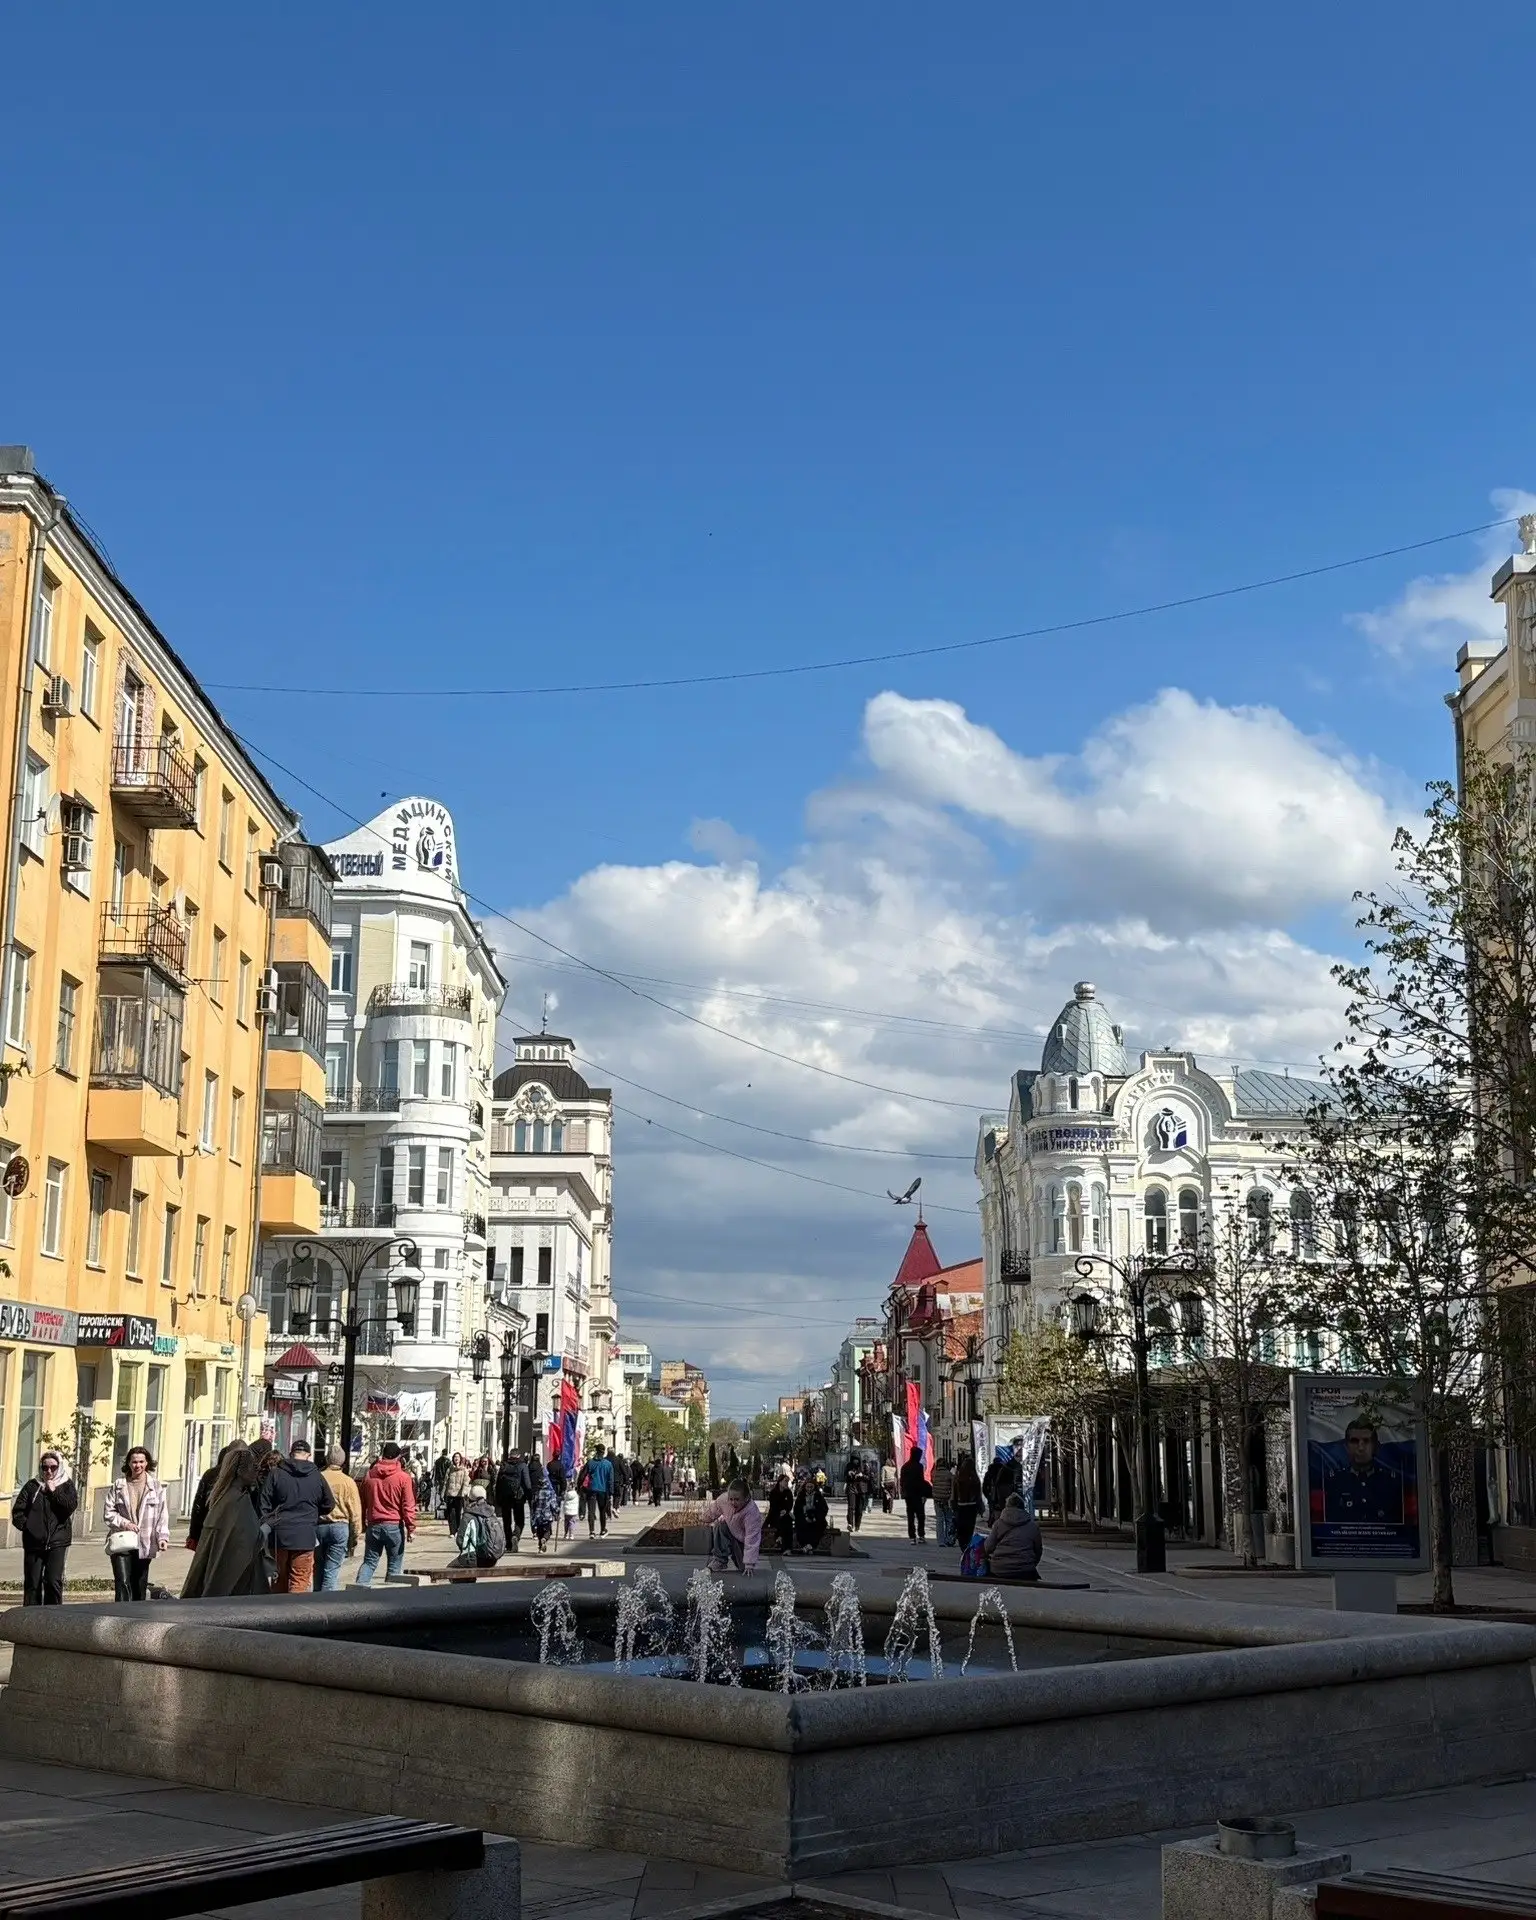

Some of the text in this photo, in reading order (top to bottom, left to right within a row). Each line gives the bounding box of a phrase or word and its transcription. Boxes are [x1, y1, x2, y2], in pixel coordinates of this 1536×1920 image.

[1051, 1138, 1121, 1152] Университет
[79, 1314, 124, 1327] ЕВРОПЕЙСКИЕ
[78, 1327, 112, 1338] МАРКИ
